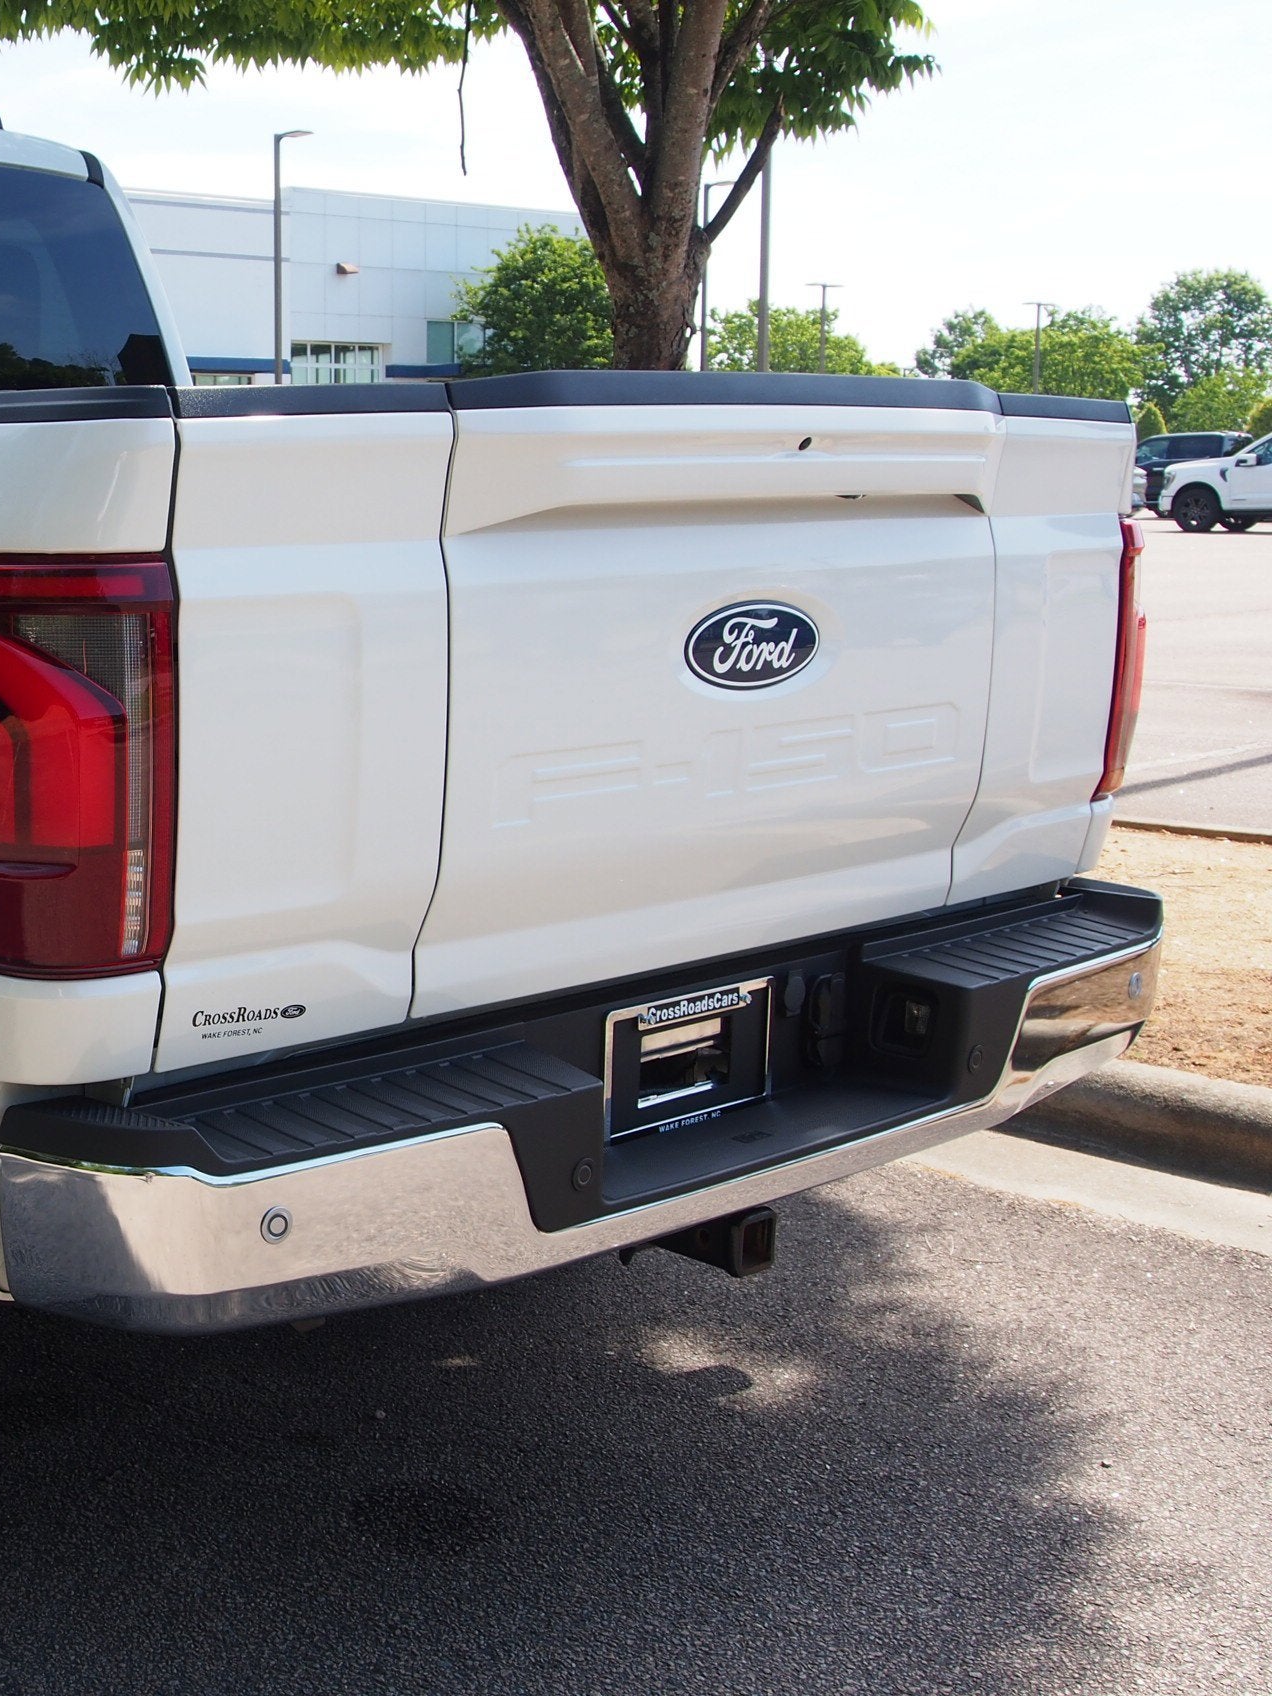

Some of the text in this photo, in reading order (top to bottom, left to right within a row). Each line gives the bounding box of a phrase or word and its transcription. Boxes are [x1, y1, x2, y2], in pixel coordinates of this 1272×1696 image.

[713, 616, 799, 674] Ford
[492, 702, 960, 828] F-150
[648, 992, 740, 1023] CrossRoadsCars
[201, 1031, 221, 1039] WAKE
[223, 1028, 252, 1038] FOREST,
[658, 1121, 680, 1133] WAKE
[711, 1110, 722, 1118] NC
